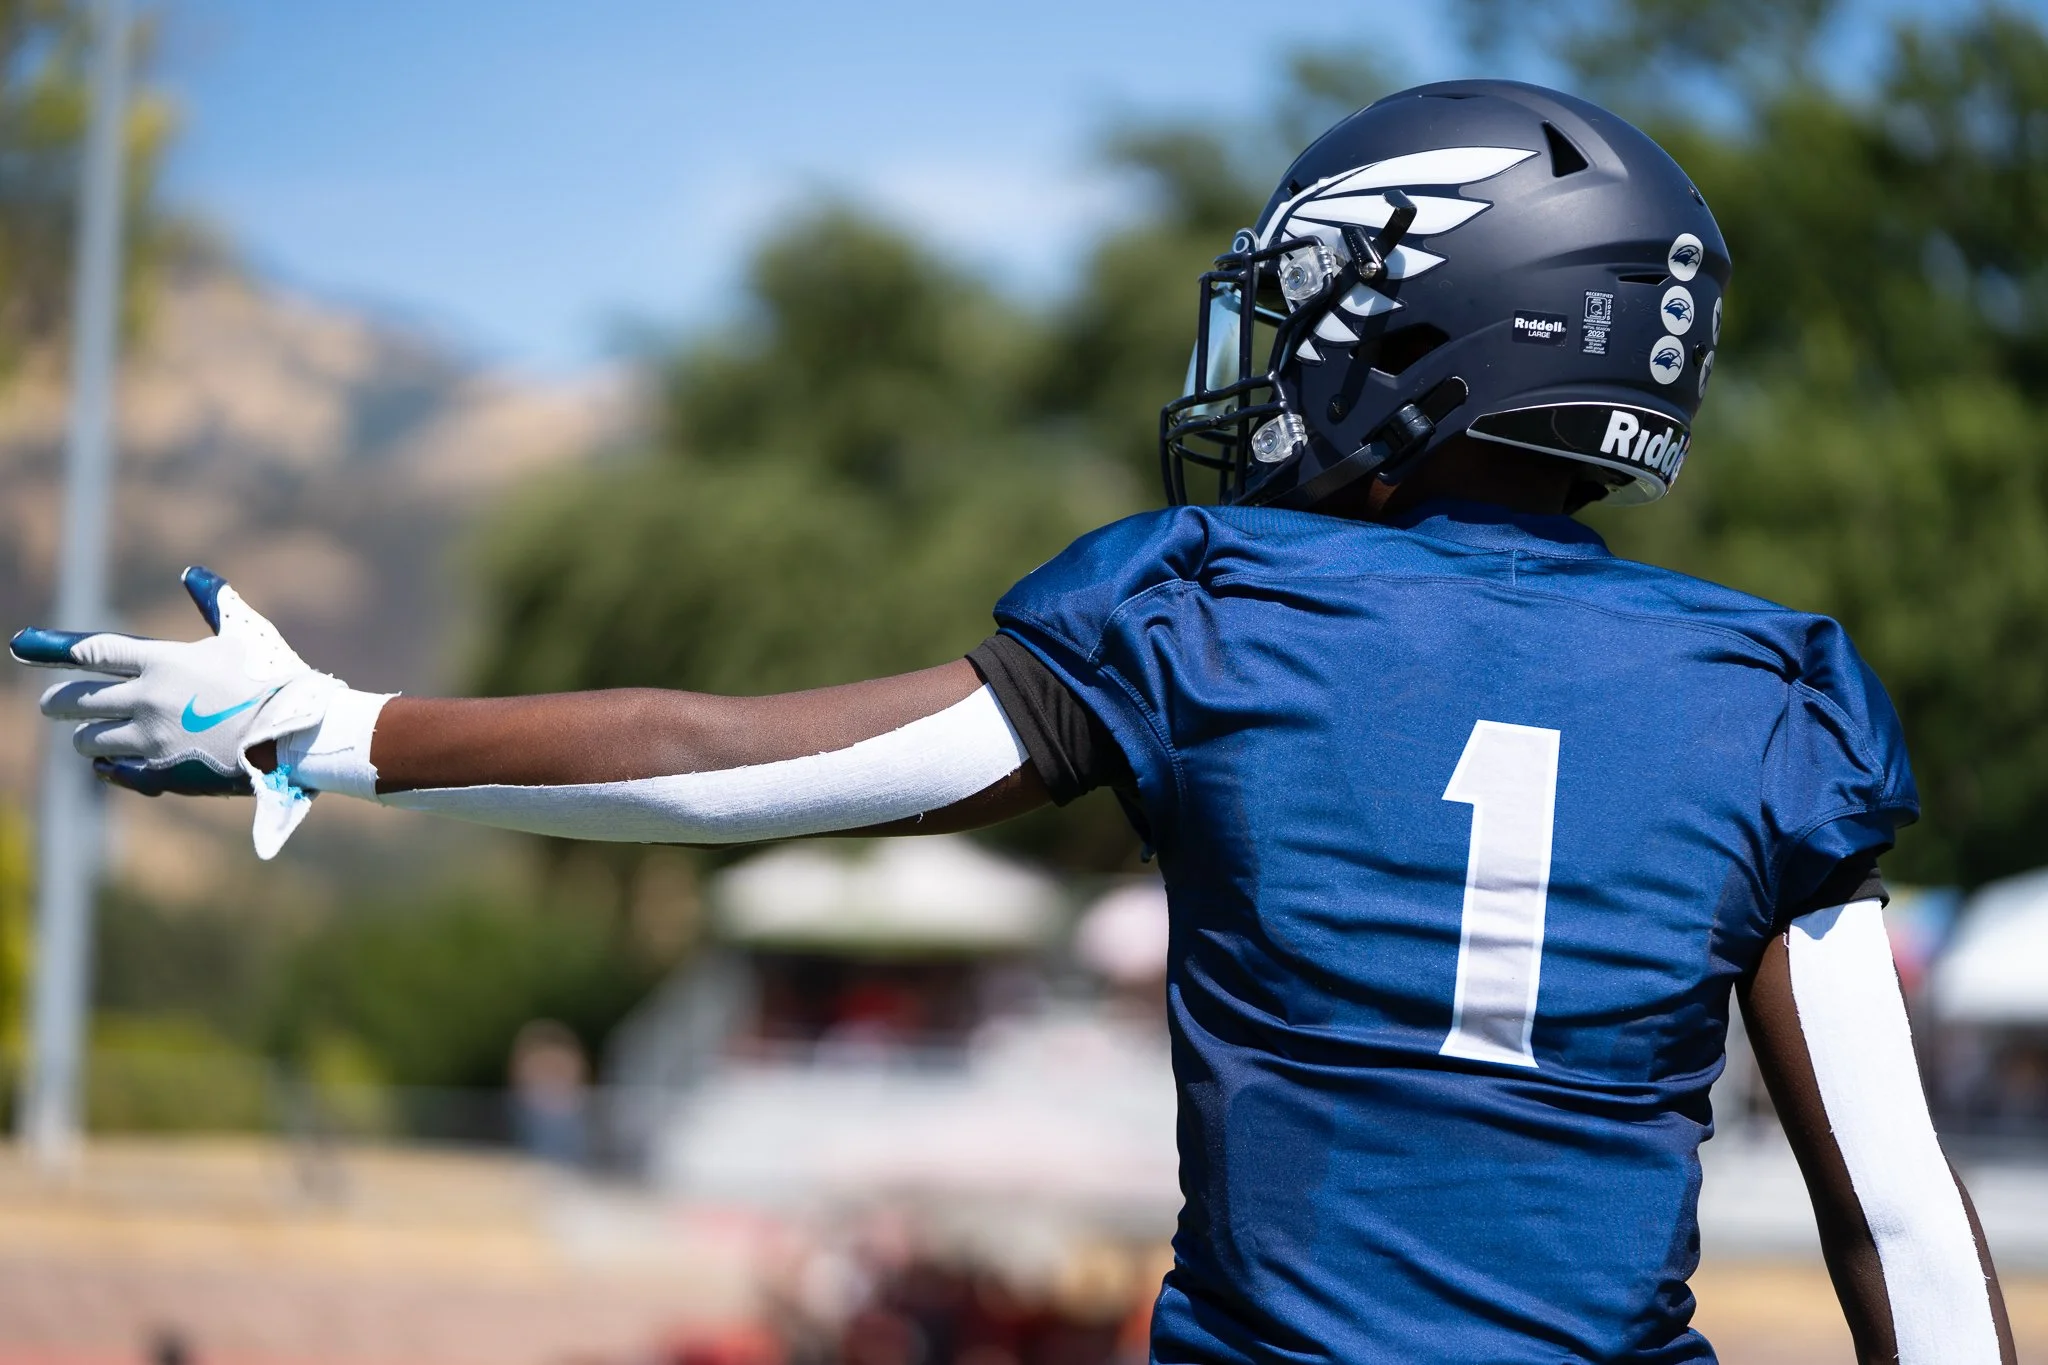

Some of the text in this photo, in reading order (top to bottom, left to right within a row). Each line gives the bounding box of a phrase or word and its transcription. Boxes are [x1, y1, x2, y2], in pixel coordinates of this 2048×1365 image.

[1528, 330, 1551, 339] LARGE
[1588, 329, 1605, 337] 2023
[1438, 719, 1561, 1069] 1
